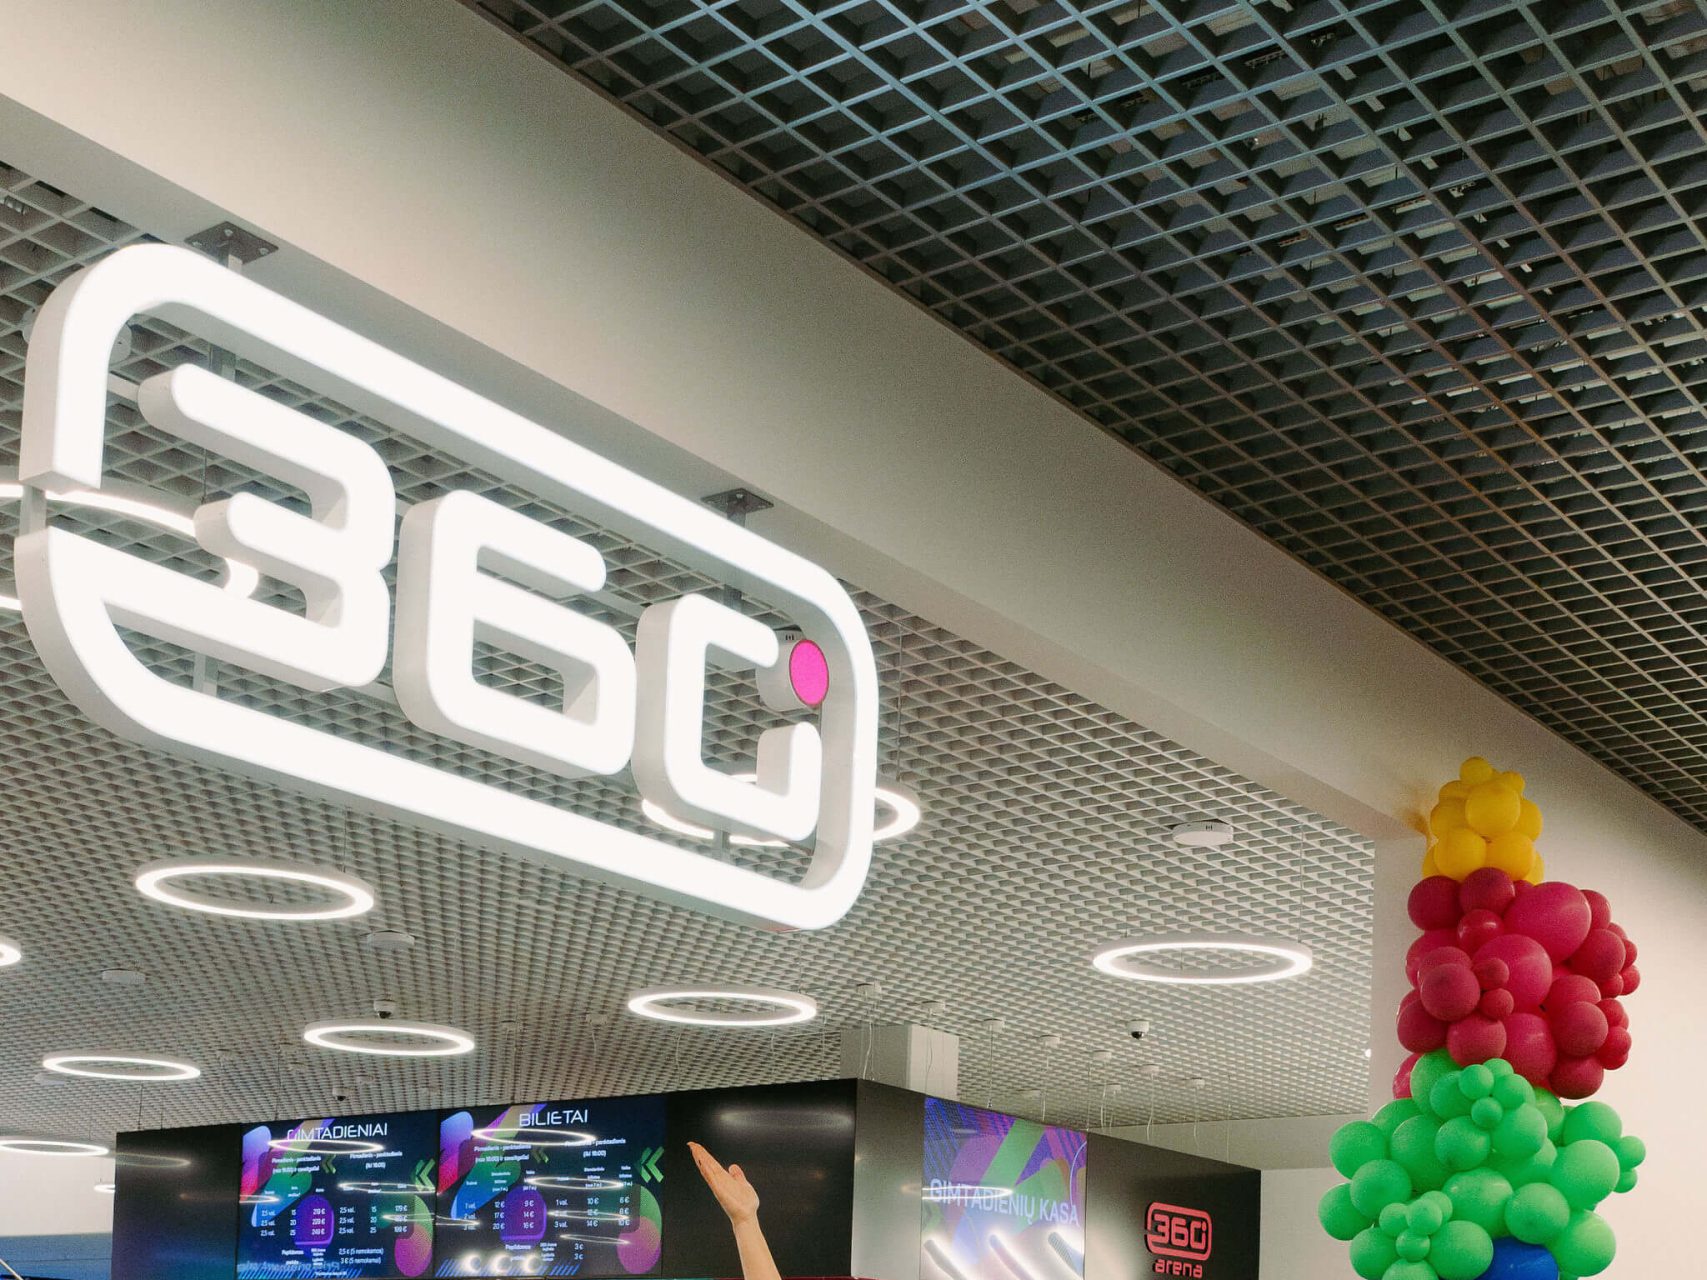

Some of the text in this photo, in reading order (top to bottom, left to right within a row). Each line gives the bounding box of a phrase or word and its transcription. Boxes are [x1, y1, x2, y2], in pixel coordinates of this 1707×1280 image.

[130, 362, 829, 842] 360
[519, 1109, 588, 1127] BILIETAI
[1039, 1198, 1080, 1227] KASA
[1149, 1212, 1208, 1251] 360
[1154, 1258, 1203, 1279] arena
